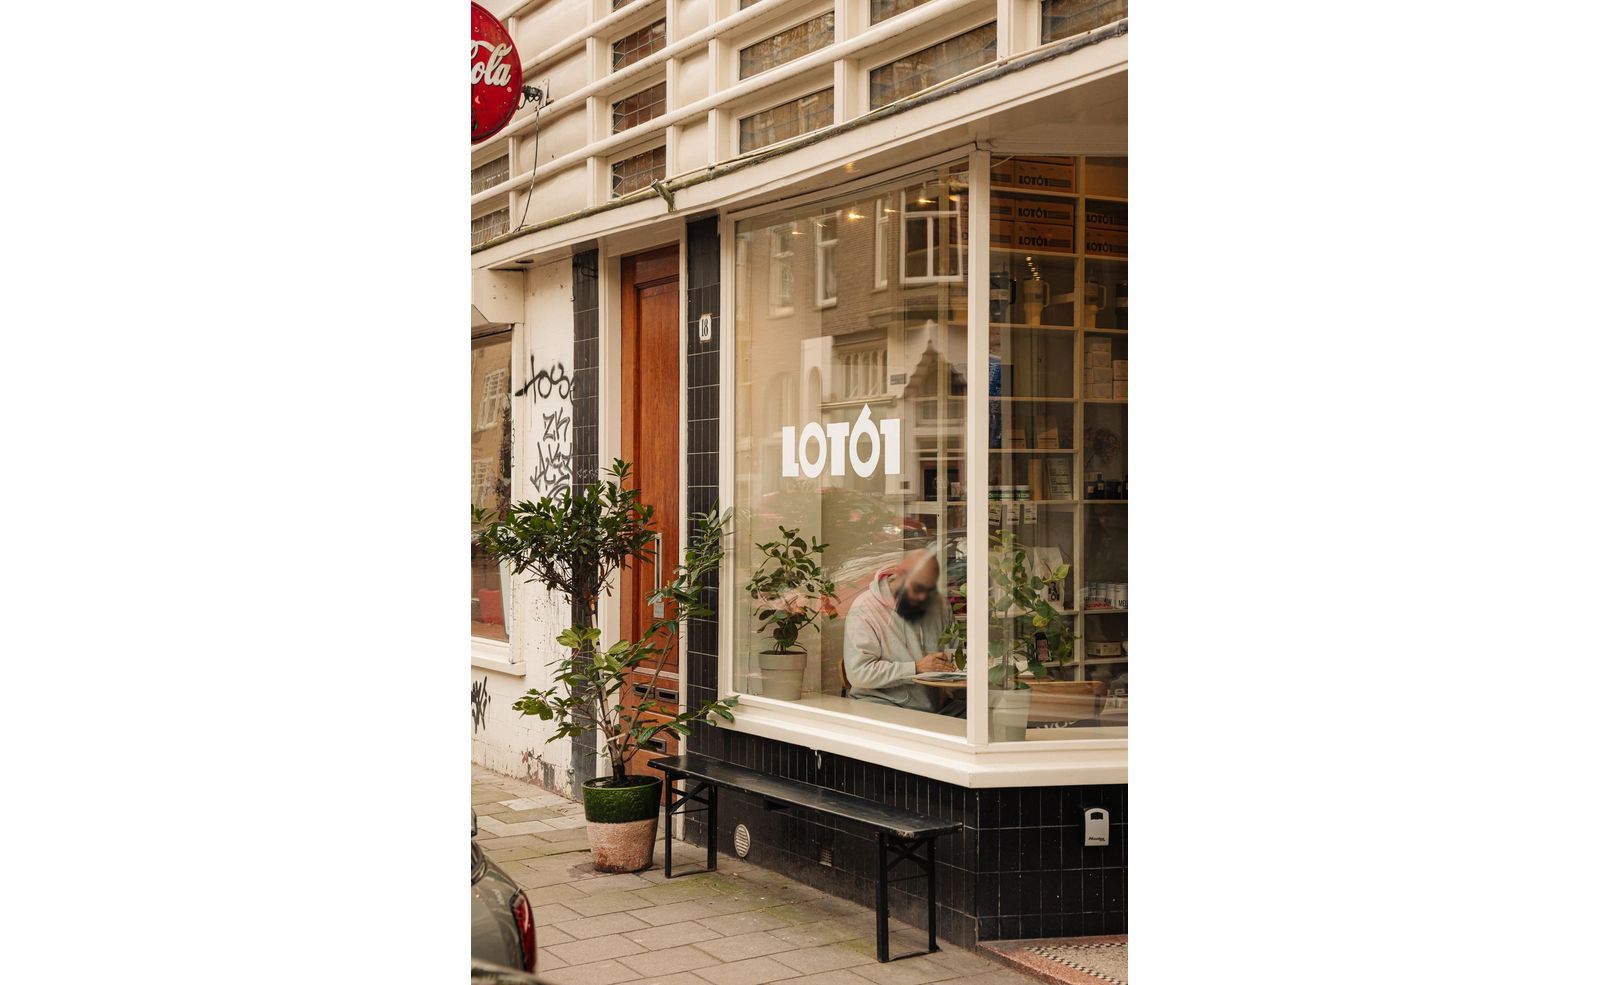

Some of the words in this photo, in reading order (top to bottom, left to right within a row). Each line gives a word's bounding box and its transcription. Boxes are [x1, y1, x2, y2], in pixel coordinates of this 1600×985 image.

[1019, 175, 1049, 187] LOT61
[1018, 207, 1048, 219] LOT61
[1019, 236, 1048, 248] LOT61
[701, 318, 709, 337] 18
[781, 402, 901, 479] LOT61
